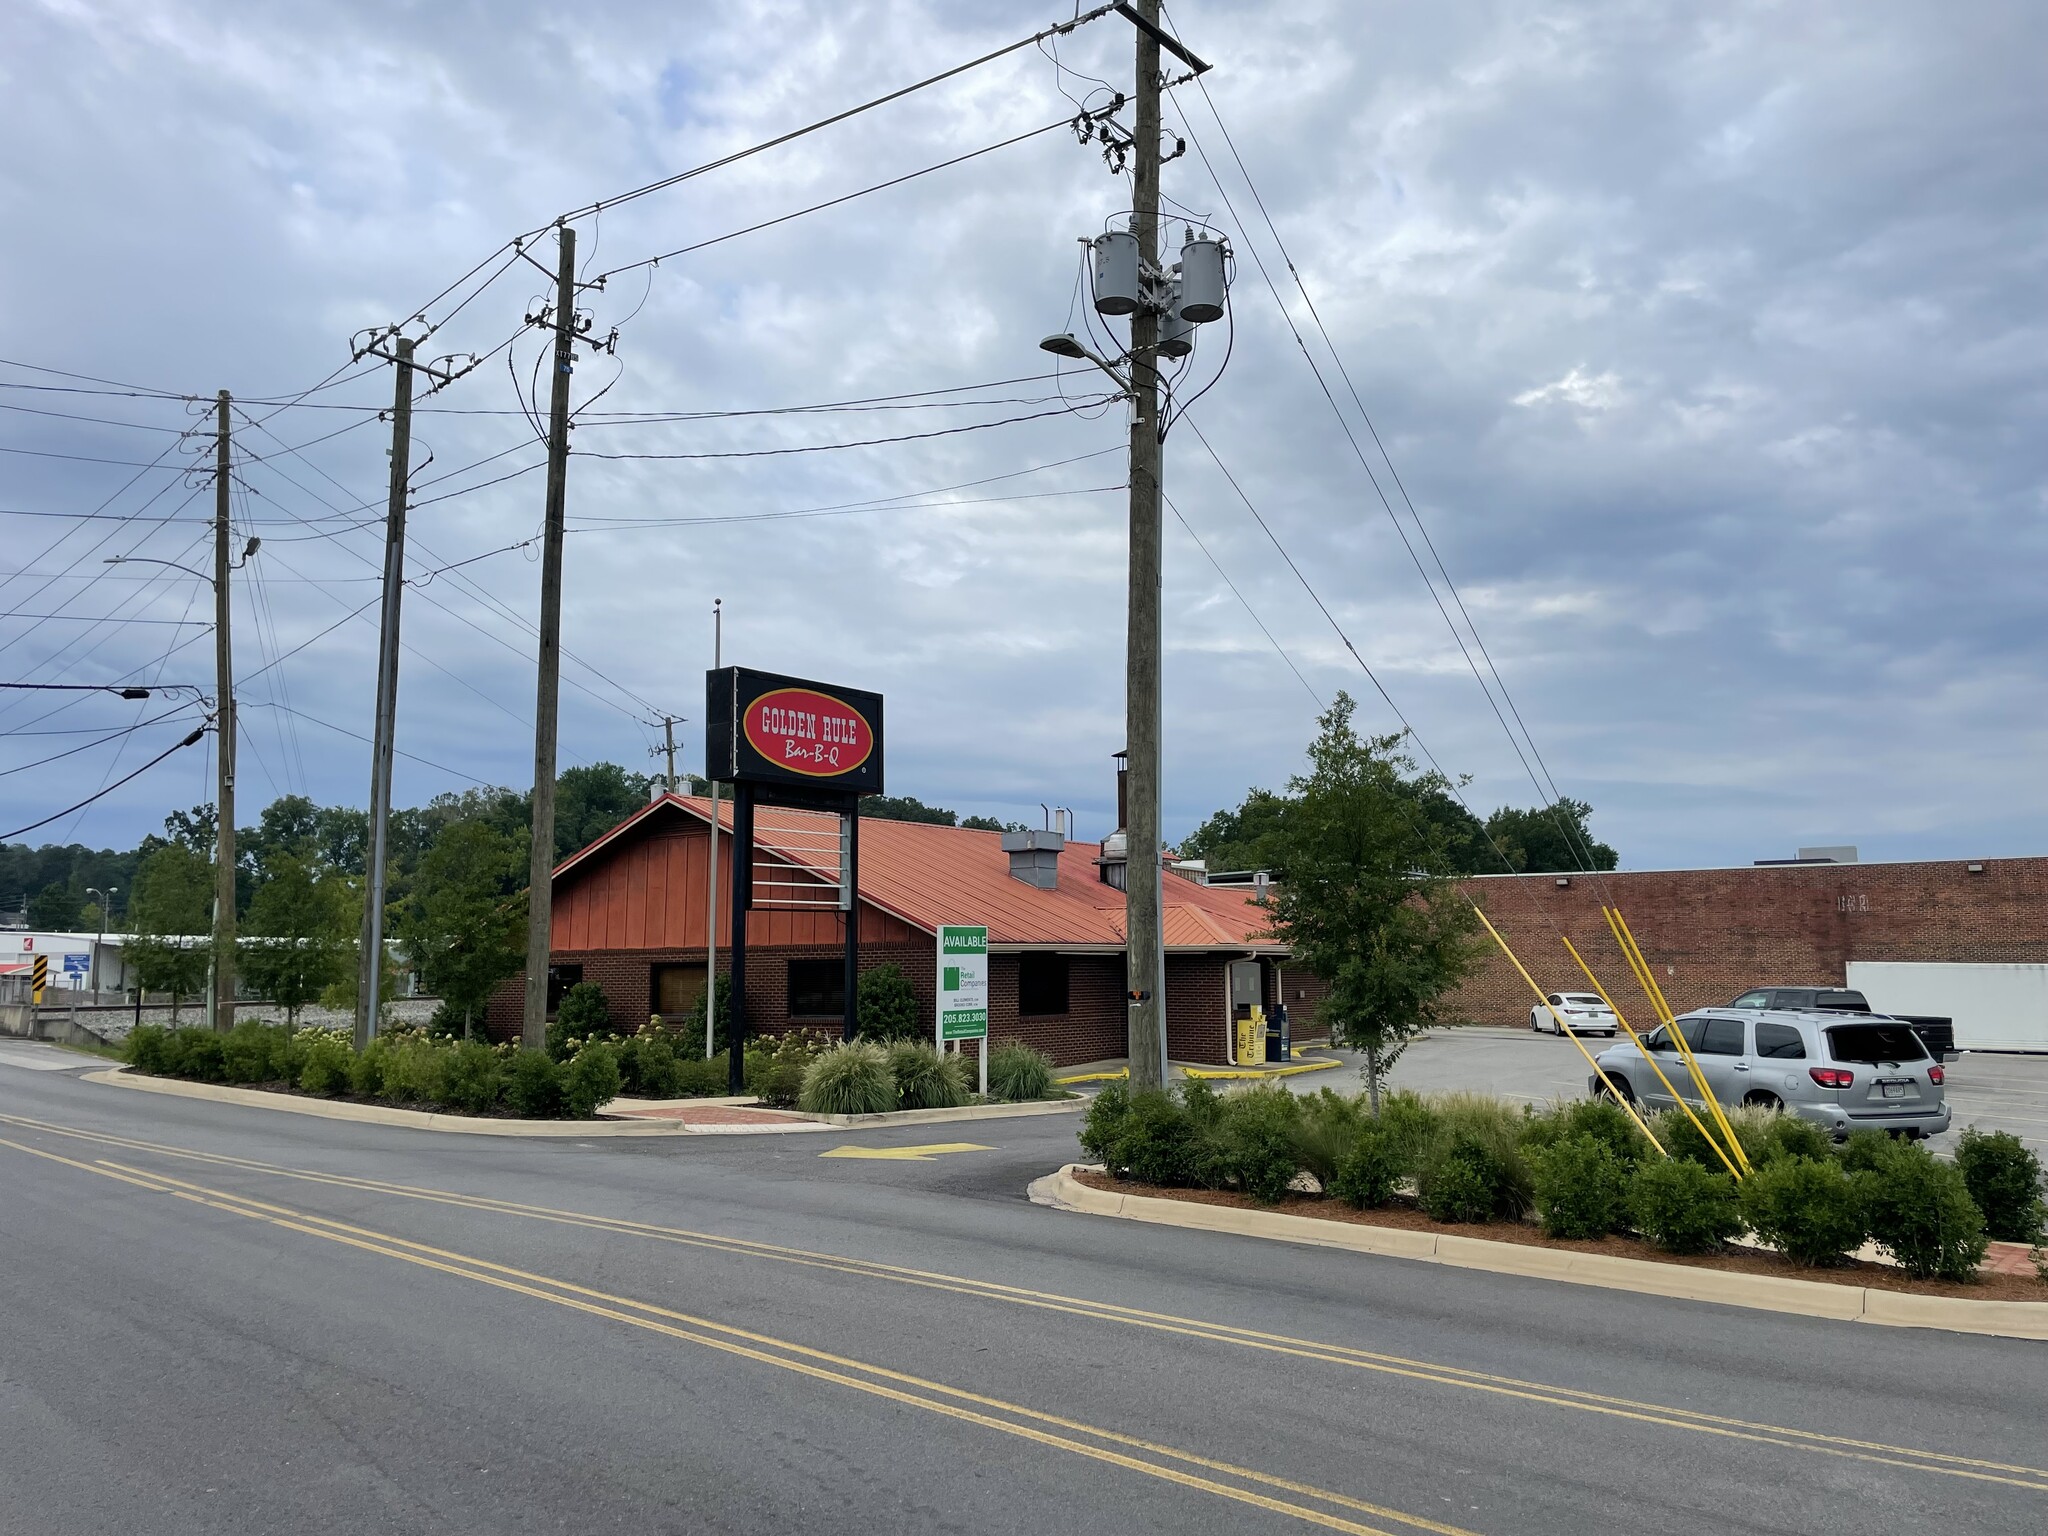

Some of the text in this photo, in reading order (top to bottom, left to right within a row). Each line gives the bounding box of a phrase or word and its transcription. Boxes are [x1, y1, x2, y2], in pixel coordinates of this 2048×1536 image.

[762, 706, 857, 745] GOLDEN RULE
[785, 739, 839, 767] Bar-B-Q
[944, 936, 986, 947] AVAILABLE
[961, 971, 975, 979] Retail
[961, 980, 987, 988] Companies
[943, 1012, 986, 1024] 205.823.3030
[1247, 1025, 1255, 1058] Tribune
